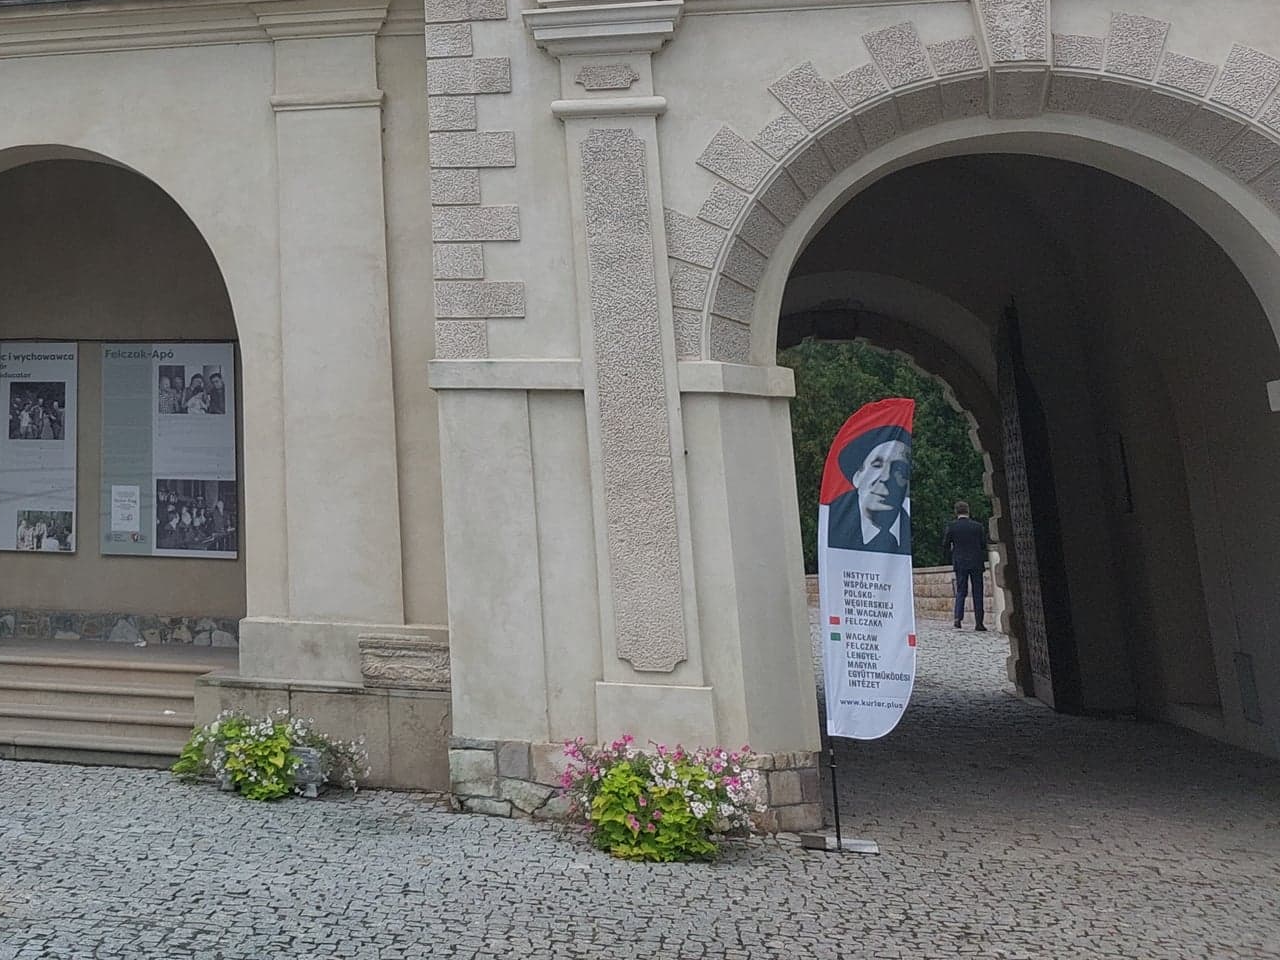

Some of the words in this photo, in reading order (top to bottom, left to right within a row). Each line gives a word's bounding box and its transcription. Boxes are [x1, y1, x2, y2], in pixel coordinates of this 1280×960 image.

[13, 350, 74, 363] wychowawca
[104, 348, 174, 361] Felczak-Apó
[843, 571, 880, 581] INSTYTUT
[843, 580, 892, 592] WSPÓŁPRACY
[844, 599, 894, 610] WĘGIERSKIEJ
[845, 617, 883, 628] FELCZAKA
[845, 632, 878, 642] WACŁAW
[846, 642, 880, 651] FELCZAK
[846, 651, 881, 661] LENGYEL-
[847, 661, 878, 670] MAGYAR
[848, 679, 881, 689] INTÉZET
